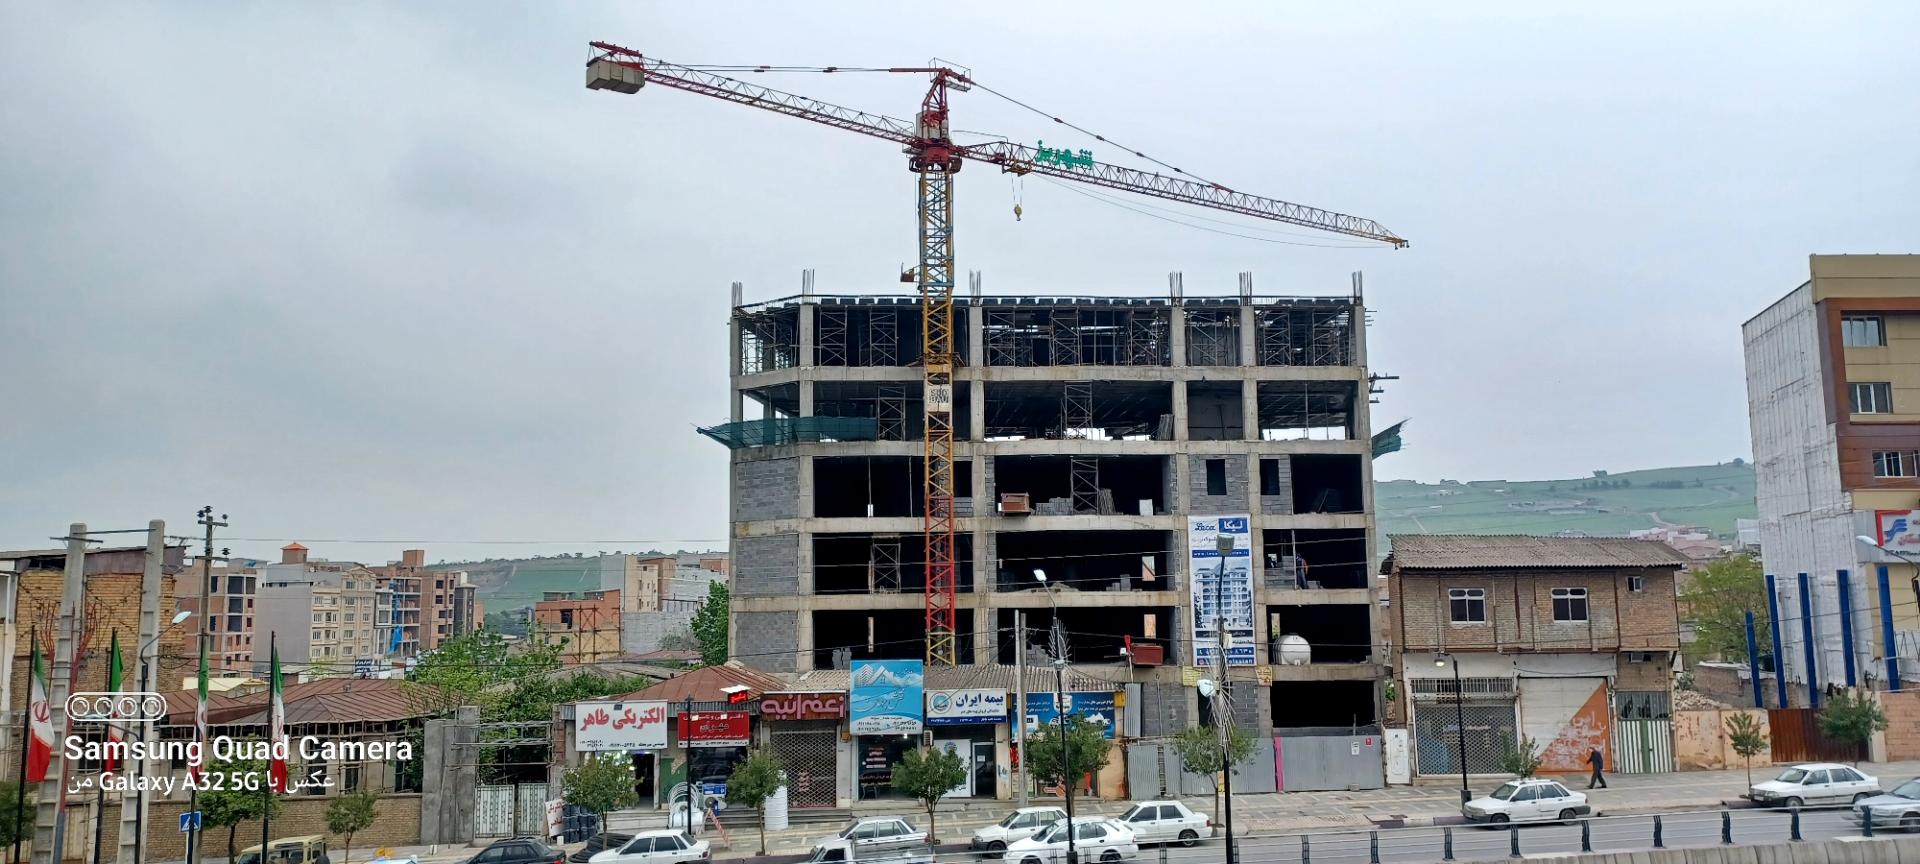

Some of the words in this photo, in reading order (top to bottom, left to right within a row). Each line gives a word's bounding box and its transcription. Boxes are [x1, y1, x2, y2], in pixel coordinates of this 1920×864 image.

[1195, 522, 1216, 531] Leca
[760, 694, 844, 720] زعفرانیه
[955, 693, 982, 707] ایران
[984, 695, 1004, 706] بیمه
[580, 707, 610, 731] طاهر
[612, 706, 665, 730] الکتریکی
